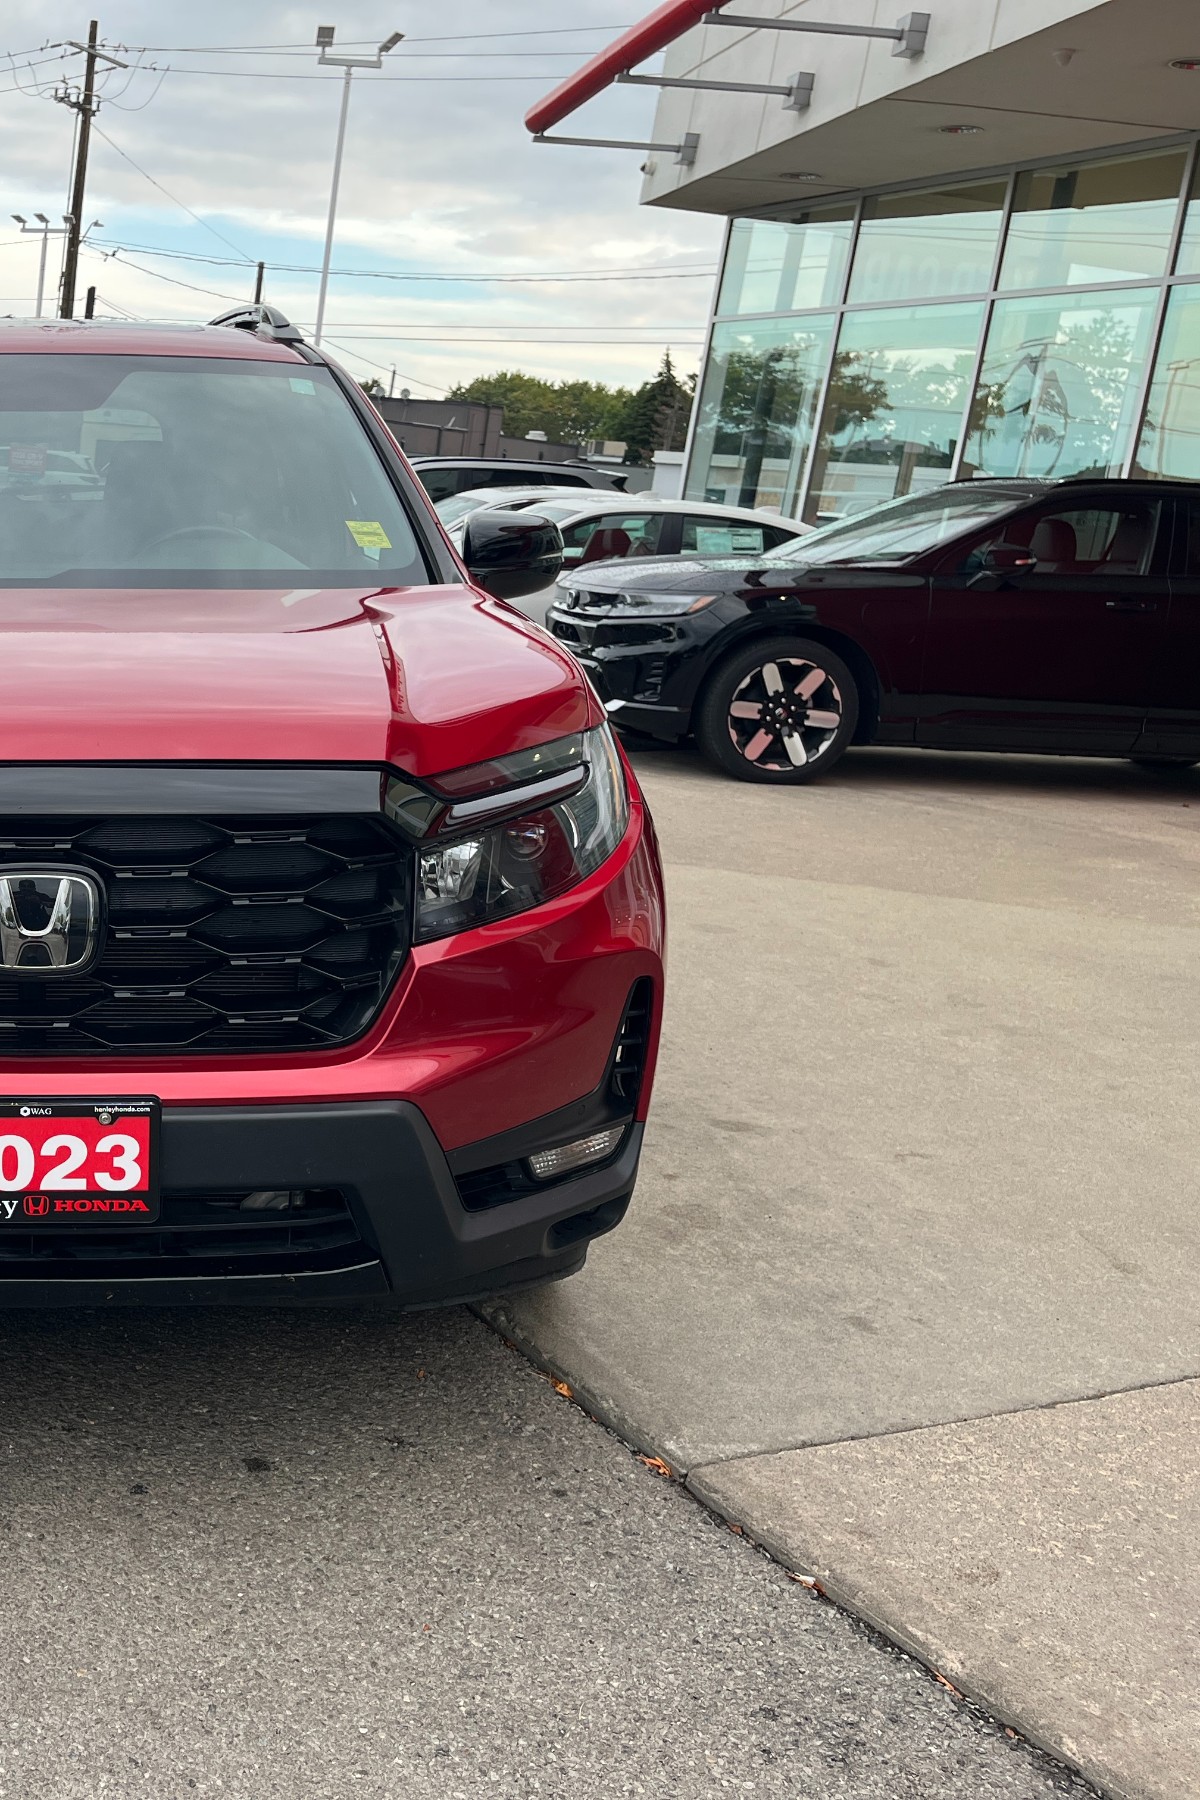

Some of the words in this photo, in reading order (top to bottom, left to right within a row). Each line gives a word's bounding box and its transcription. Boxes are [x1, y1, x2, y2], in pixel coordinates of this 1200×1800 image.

[31, 1107, 52, 1115] WAG
[94, 1106, 151, 1114] henleyhonda.com
[53, 1199, 150, 1212] HONDA
